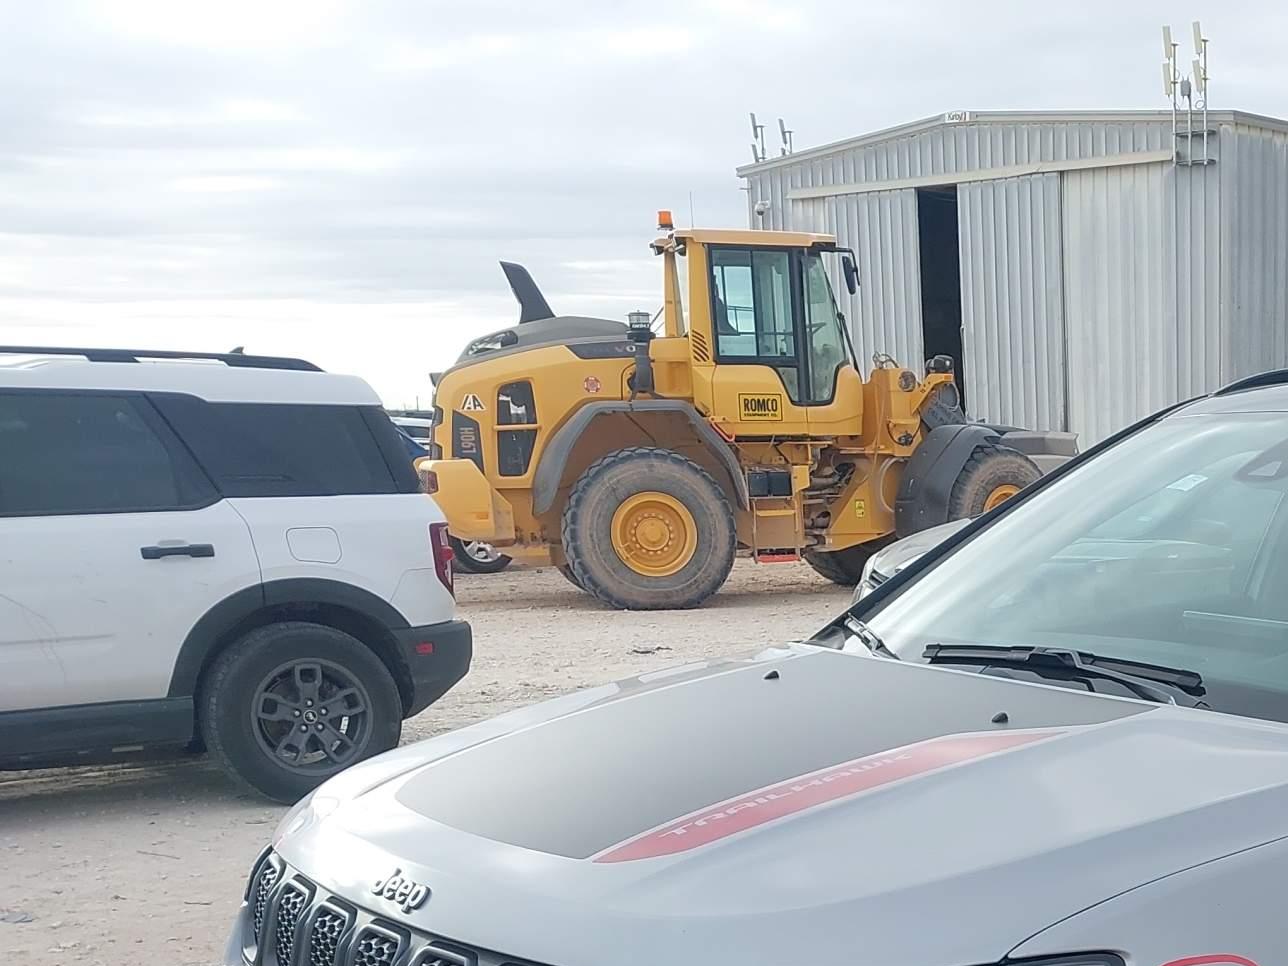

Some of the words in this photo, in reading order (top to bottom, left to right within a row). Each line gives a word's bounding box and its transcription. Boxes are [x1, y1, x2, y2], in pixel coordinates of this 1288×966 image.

[743, 398, 778, 412] ROMCO
[459, 427, 476, 453] L90H
[657, 753, 913, 838] TRAILHAWK
[371, 868, 431, 914] Jeep
